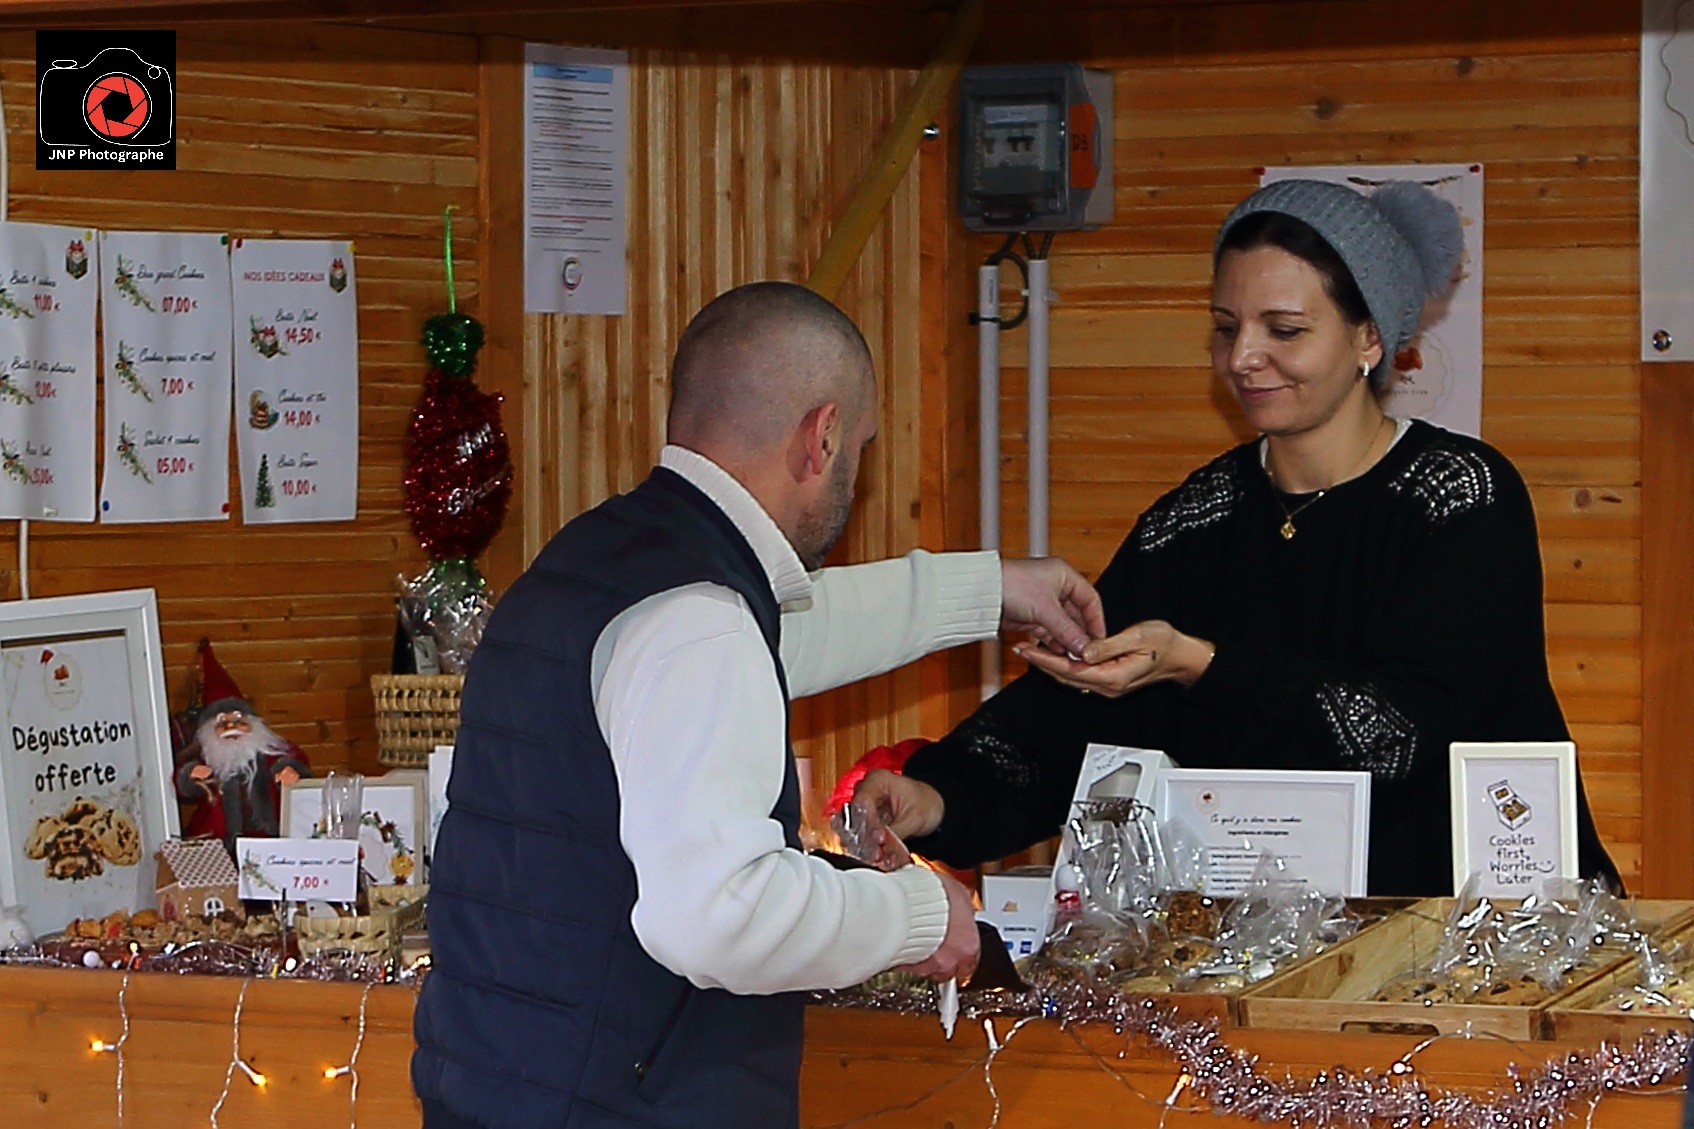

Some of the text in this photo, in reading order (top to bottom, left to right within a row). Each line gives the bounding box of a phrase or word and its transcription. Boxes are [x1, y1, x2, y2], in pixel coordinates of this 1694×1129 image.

[244, 271, 262, 281] NOS
[288, 271, 325, 282] CADEAUX
[162, 296, 190, 315] 07,00
[285, 326, 314, 345] 14,50
[161, 377, 185, 396] 7,00
[284, 410, 313, 428] 14,00
[156, 457, 187, 476] 05,00
[281, 479, 311, 498] 10,00
[12, 720, 131, 754] Dégustation
[35, 762, 117, 792] offerte
[1489, 834, 1535, 847] Cookies
[266, 855, 296, 866] Cookies
[1497, 847, 1530, 861] first,
[1489, 860, 1537, 872] Worries
[293, 876, 320, 890] 7,00
[1496, 873, 1533, 885] Later
